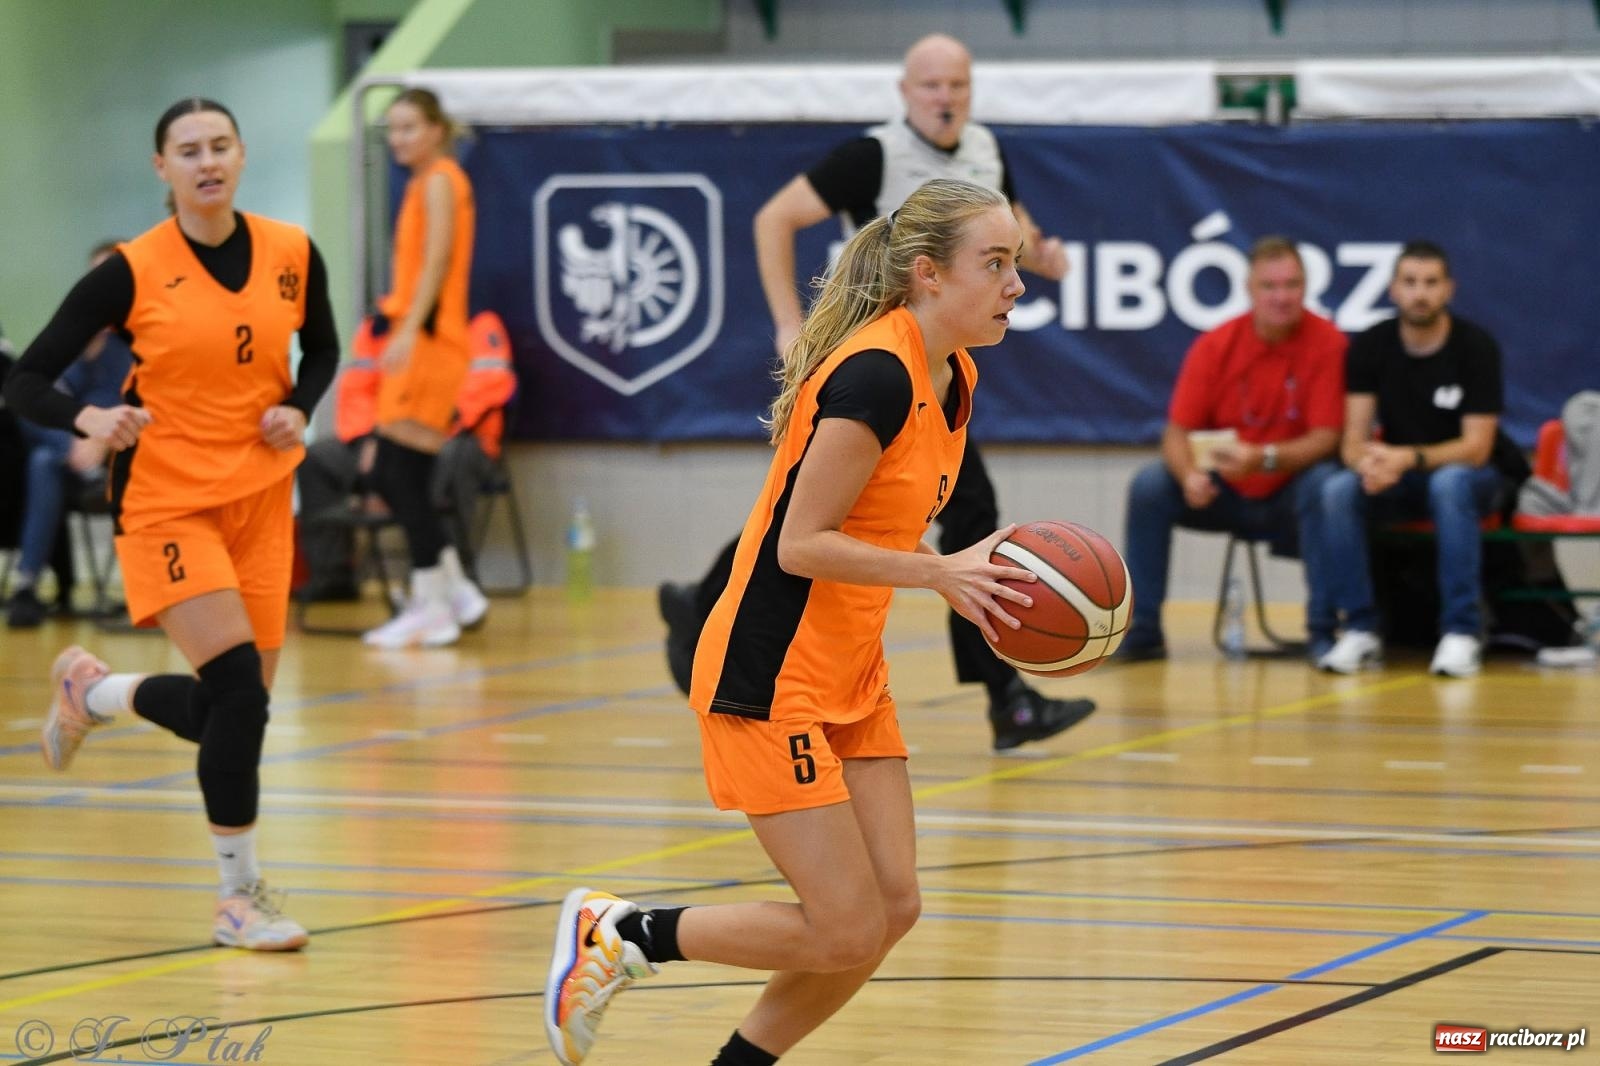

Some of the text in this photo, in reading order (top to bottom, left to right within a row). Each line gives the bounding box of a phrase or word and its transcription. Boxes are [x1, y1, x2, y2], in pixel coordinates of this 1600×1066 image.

[828, 211, 1403, 332] IBÓZ
[236, 325, 252, 364] 2
[164, 543, 185, 582] 2
[788, 733, 816, 785] 5
